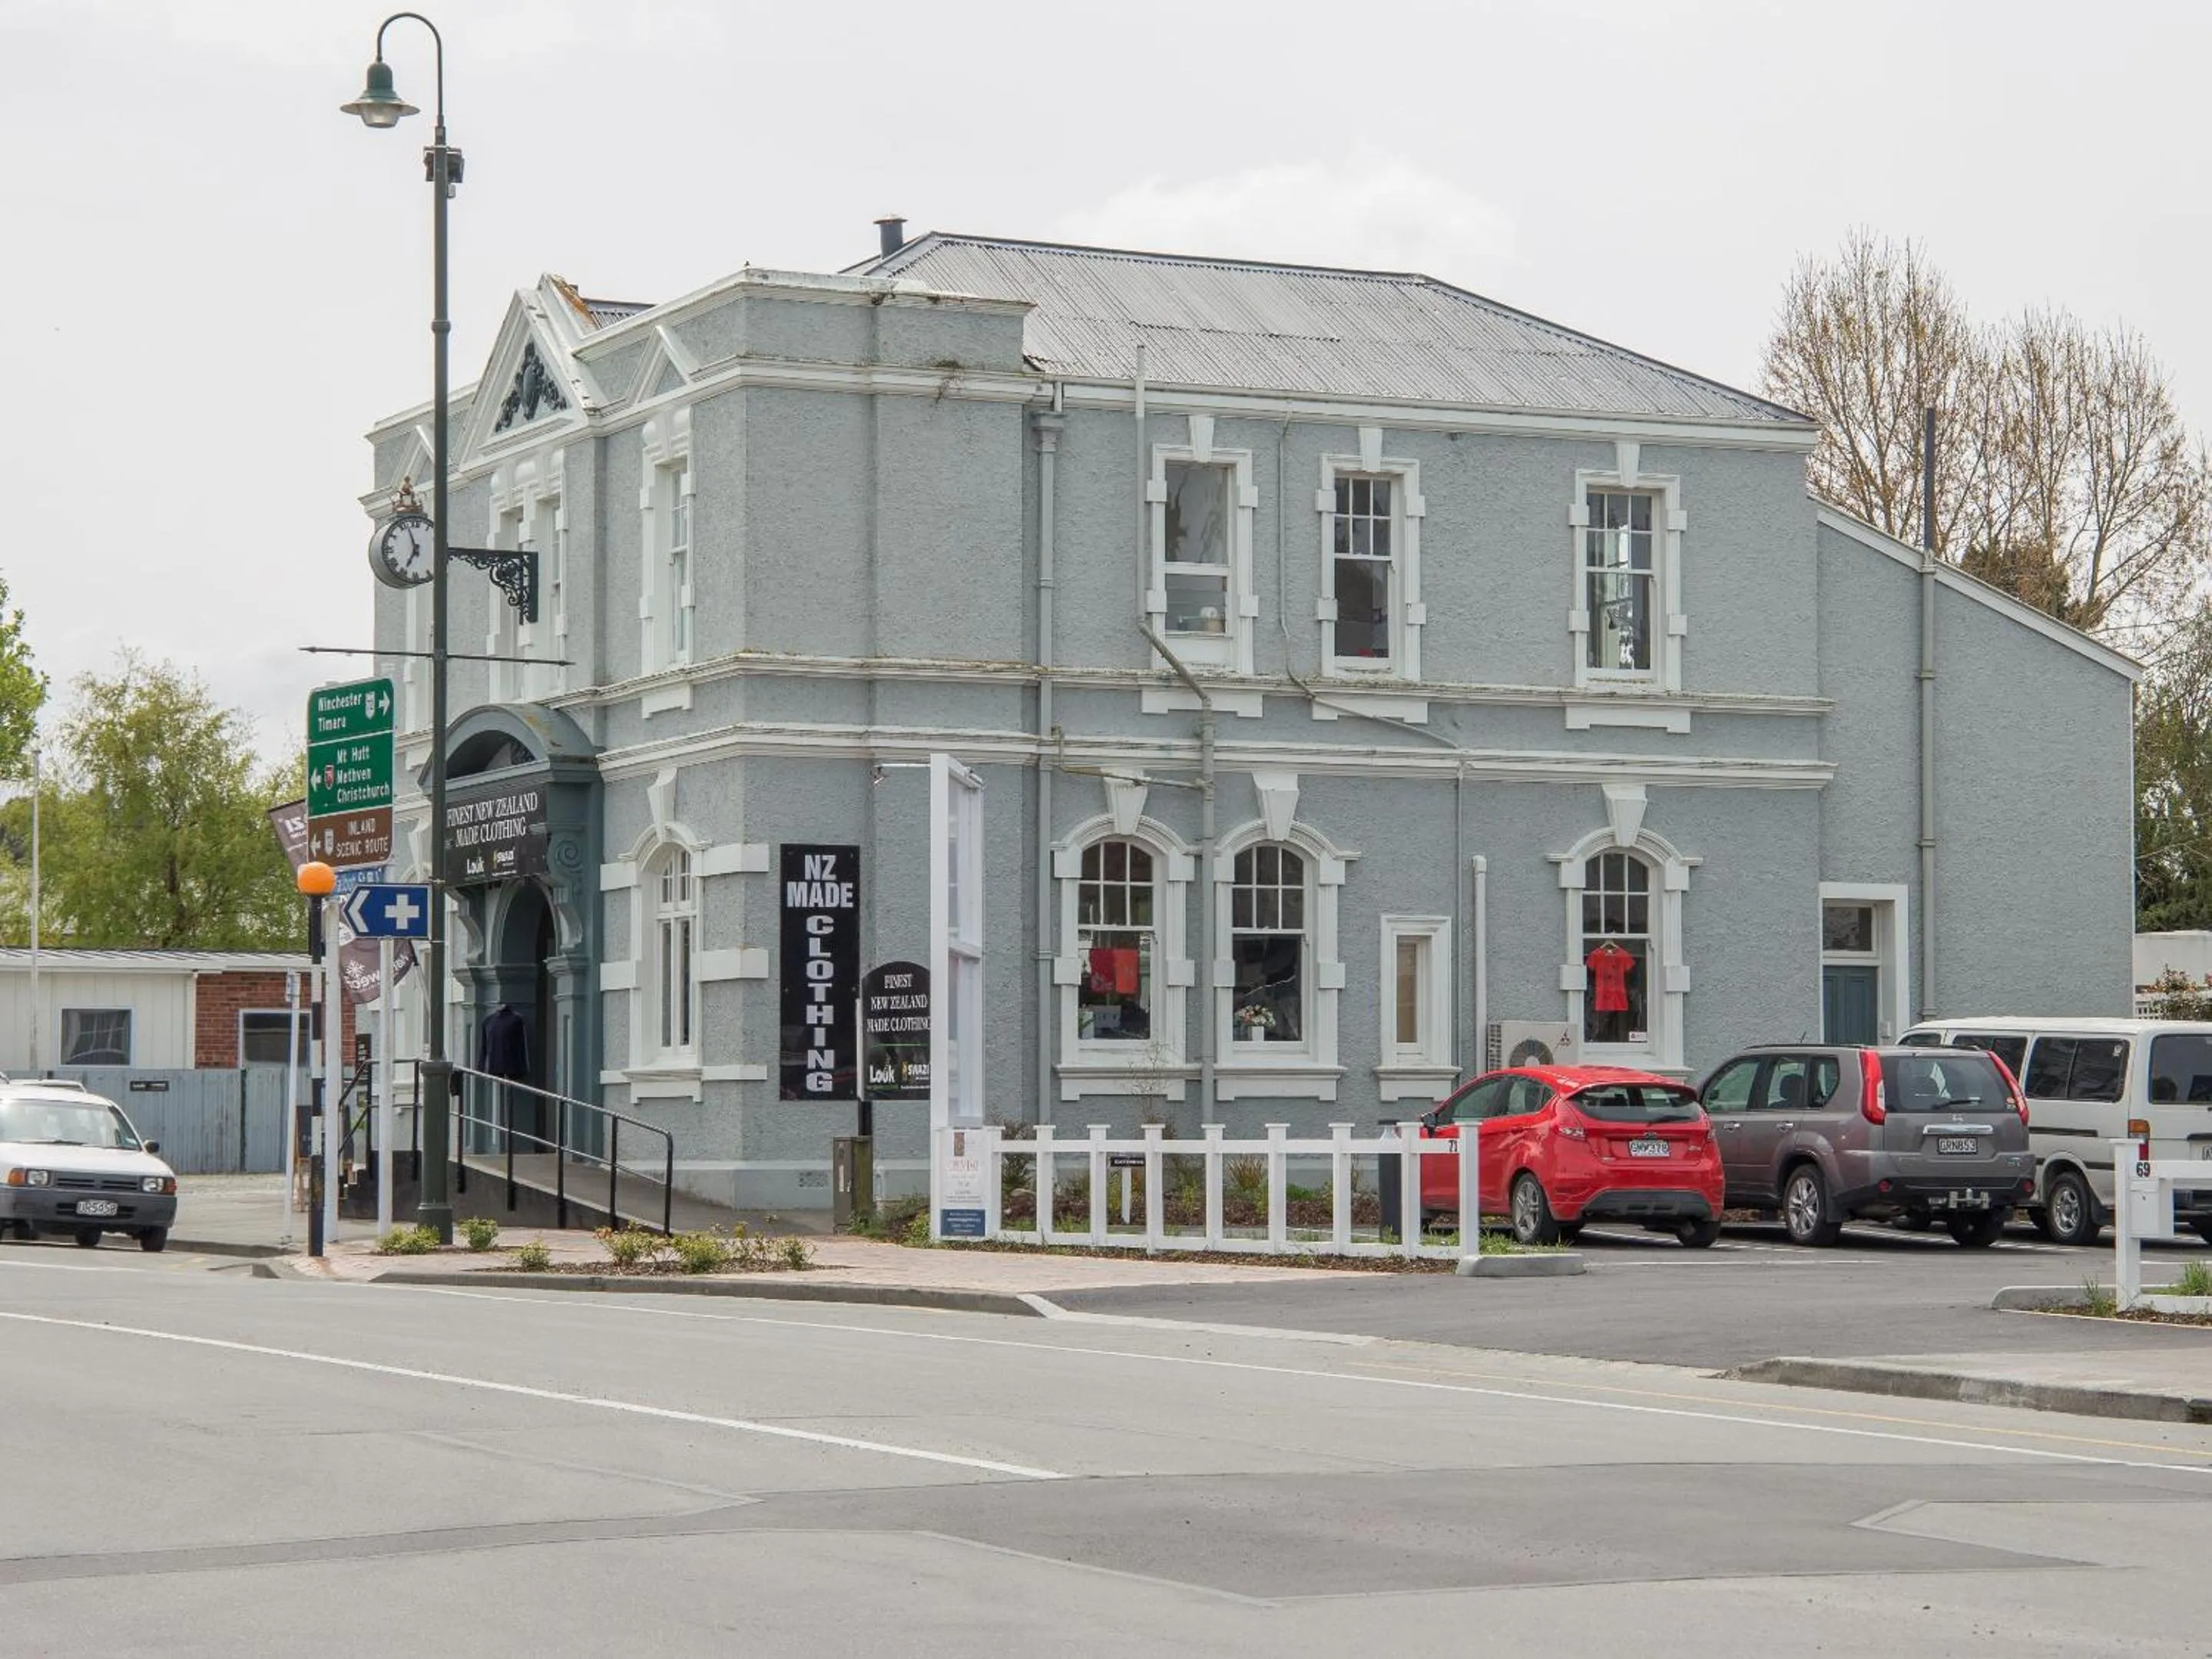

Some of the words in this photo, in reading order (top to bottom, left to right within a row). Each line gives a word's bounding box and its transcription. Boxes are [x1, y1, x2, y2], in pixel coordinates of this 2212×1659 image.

[318, 693, 362, 712] Winchester
[318, 716, 346, 732] Timaru
[337, 748, 347, 764] Mt
[352, 745, 369, 761] Hutt
[337, 768, 372, 784] Methven
[337, 781, 389, 803] Christchurch
[447, 804, 474, 827] FINEST
[475, 800, 495, 822] NEW
[495, 791, 538, 818] ZEALAND
[348, 818, 376, 835] INLAND
[455, 825, 479, 847] MADE
[480, 816, 525, 843] CLOTHING
[336, 842, 363, 858] SCENIC
[365, 836, 389, 854] ROUTE
[804, 854, 836, 881] NZ
[786, 882, 854, 908] MADE
[884, 974, 912, 989] FINEST
[806, 915, 835, 1092] CLOTHING
[870, 996, 889, 1011] NEW
[890, 994, 928, 1009] ZEALAND
[866, 1018, 889, 1032] MADE
[2136, 1162, 2151, 1177] 69
